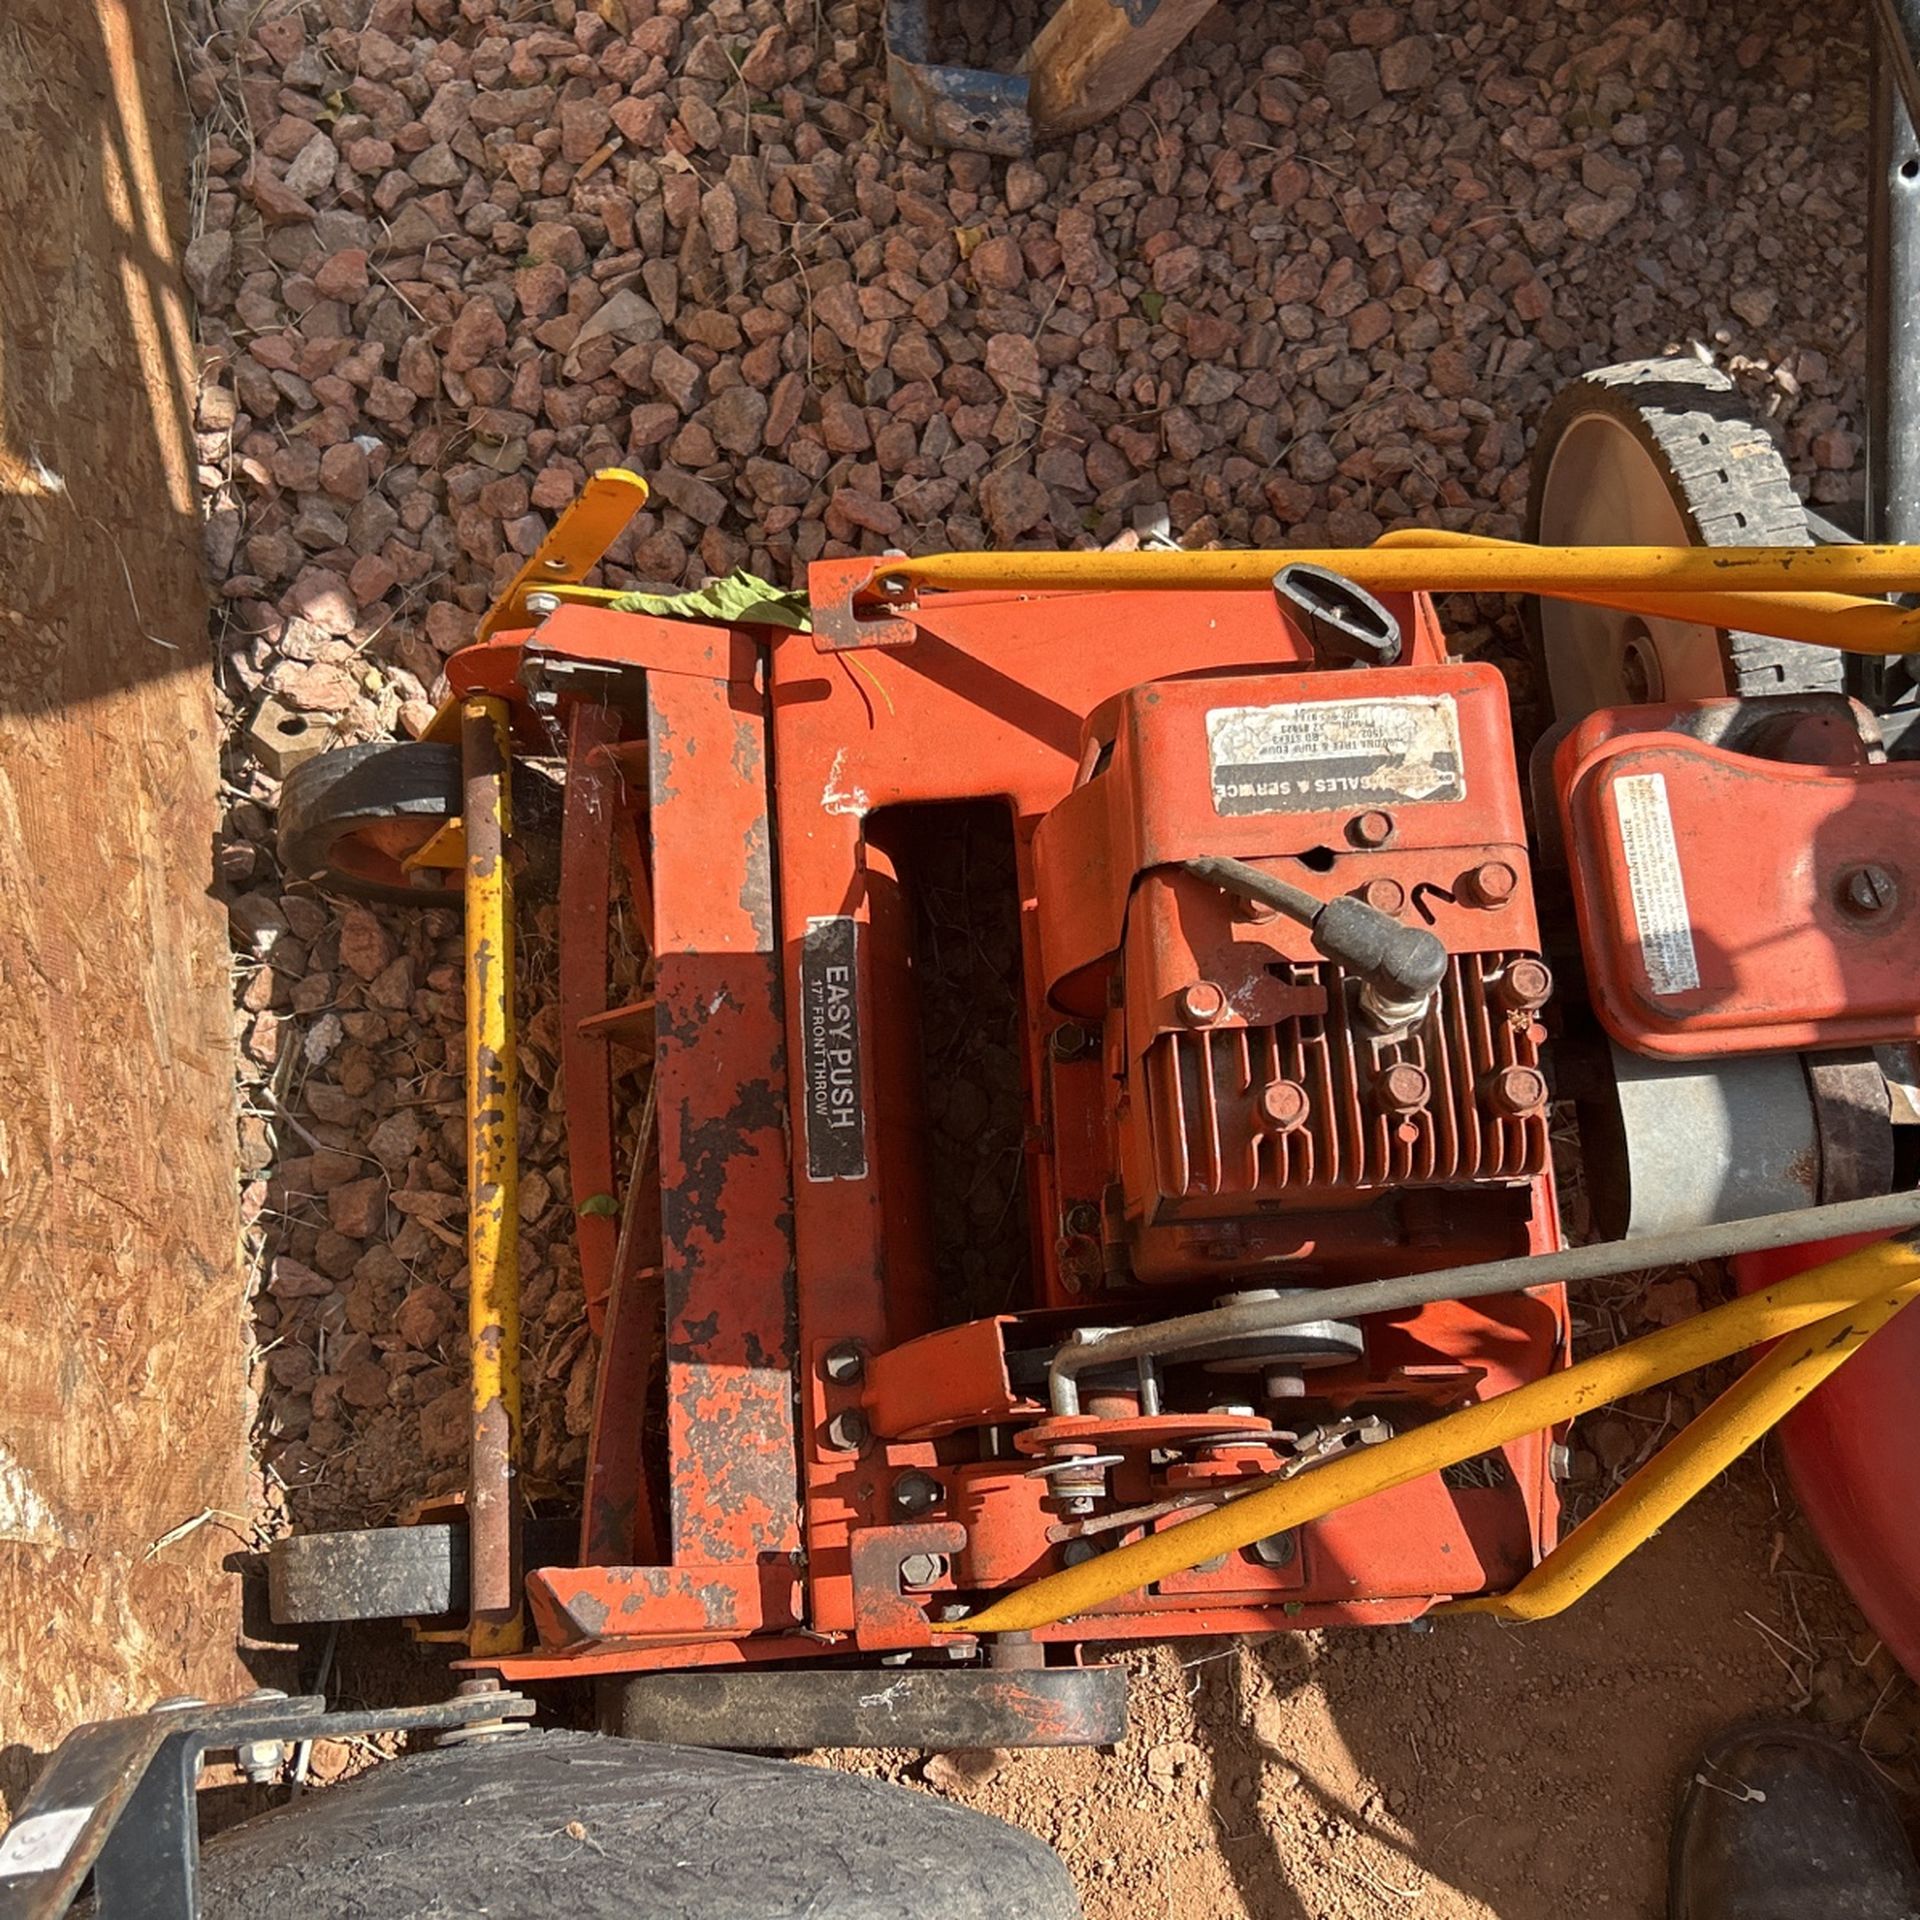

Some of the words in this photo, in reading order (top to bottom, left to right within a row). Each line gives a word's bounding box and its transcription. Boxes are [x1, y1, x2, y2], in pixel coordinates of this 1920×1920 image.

[1315, 776, 1369, 792] SALES
[1623, 819, 1642, 886] MAINTENANCE
[1635, 887, 1649, 931] CLEANER
[812, 1007, 826, 1056] FRONT
[826, 965, 852, 1044] EASY
[814, 1061, 828, 1116] THROW
[829, 1048, 855, 1128] PUSH
